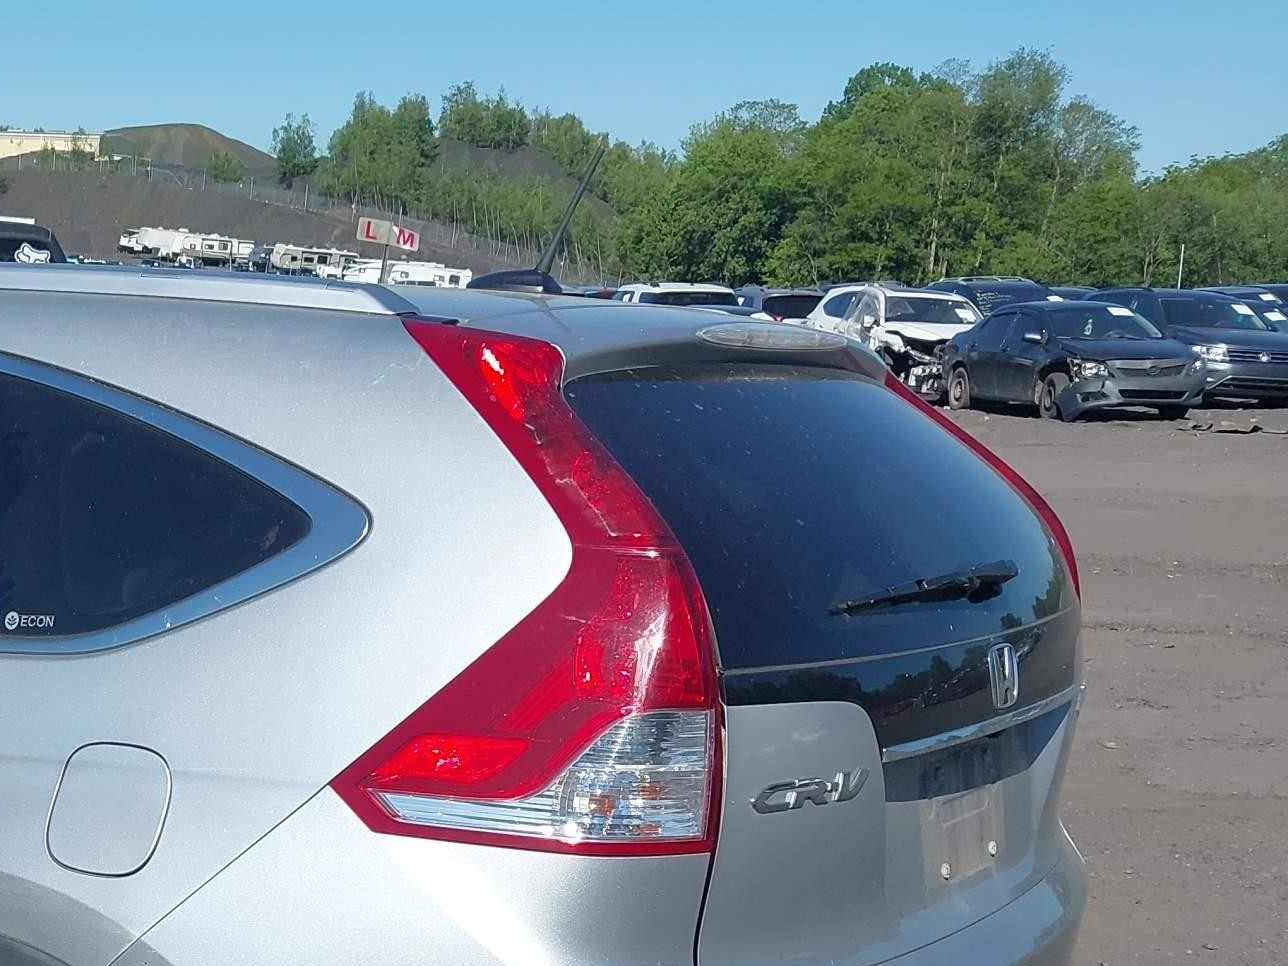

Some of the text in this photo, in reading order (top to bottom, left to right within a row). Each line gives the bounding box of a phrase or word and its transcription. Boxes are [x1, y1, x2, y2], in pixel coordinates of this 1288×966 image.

[364, 220, 378, 241] L
[396, 227, 416, 248] M
[20, 615, 55, 628] ECON
[749, 767, 871, 815] CR-V
